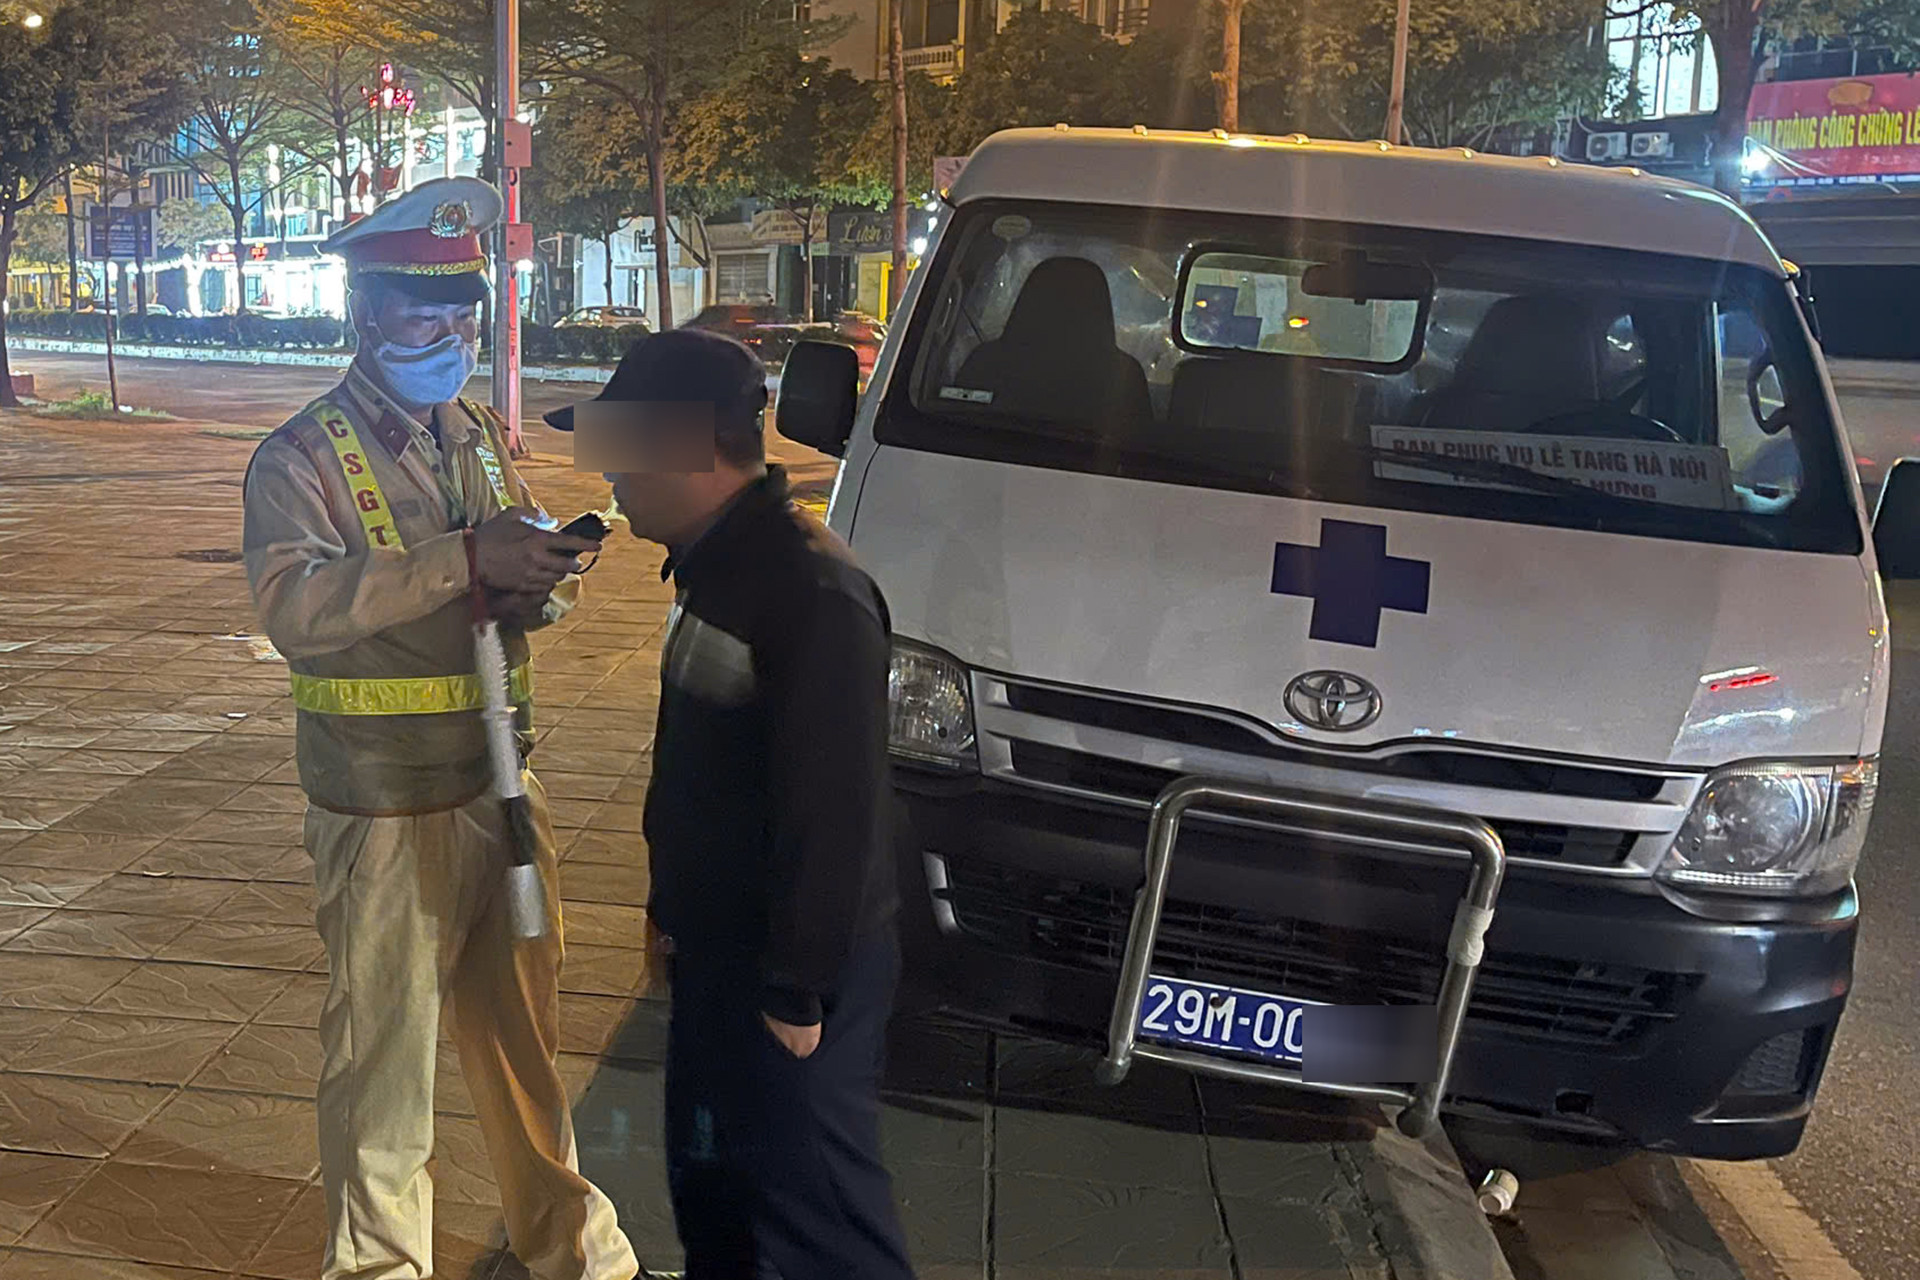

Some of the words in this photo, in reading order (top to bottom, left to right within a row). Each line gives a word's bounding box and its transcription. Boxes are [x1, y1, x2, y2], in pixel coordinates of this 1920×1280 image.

[1775, 110, 1817, 151] PHÒNG
[1819, 109, 1856, 148] CÔNG
[1571, 450, 1629, 472] TANG
[1634, 451, 1663, 477] HÀ
[1669, 455, 1708, 483] NỘI
